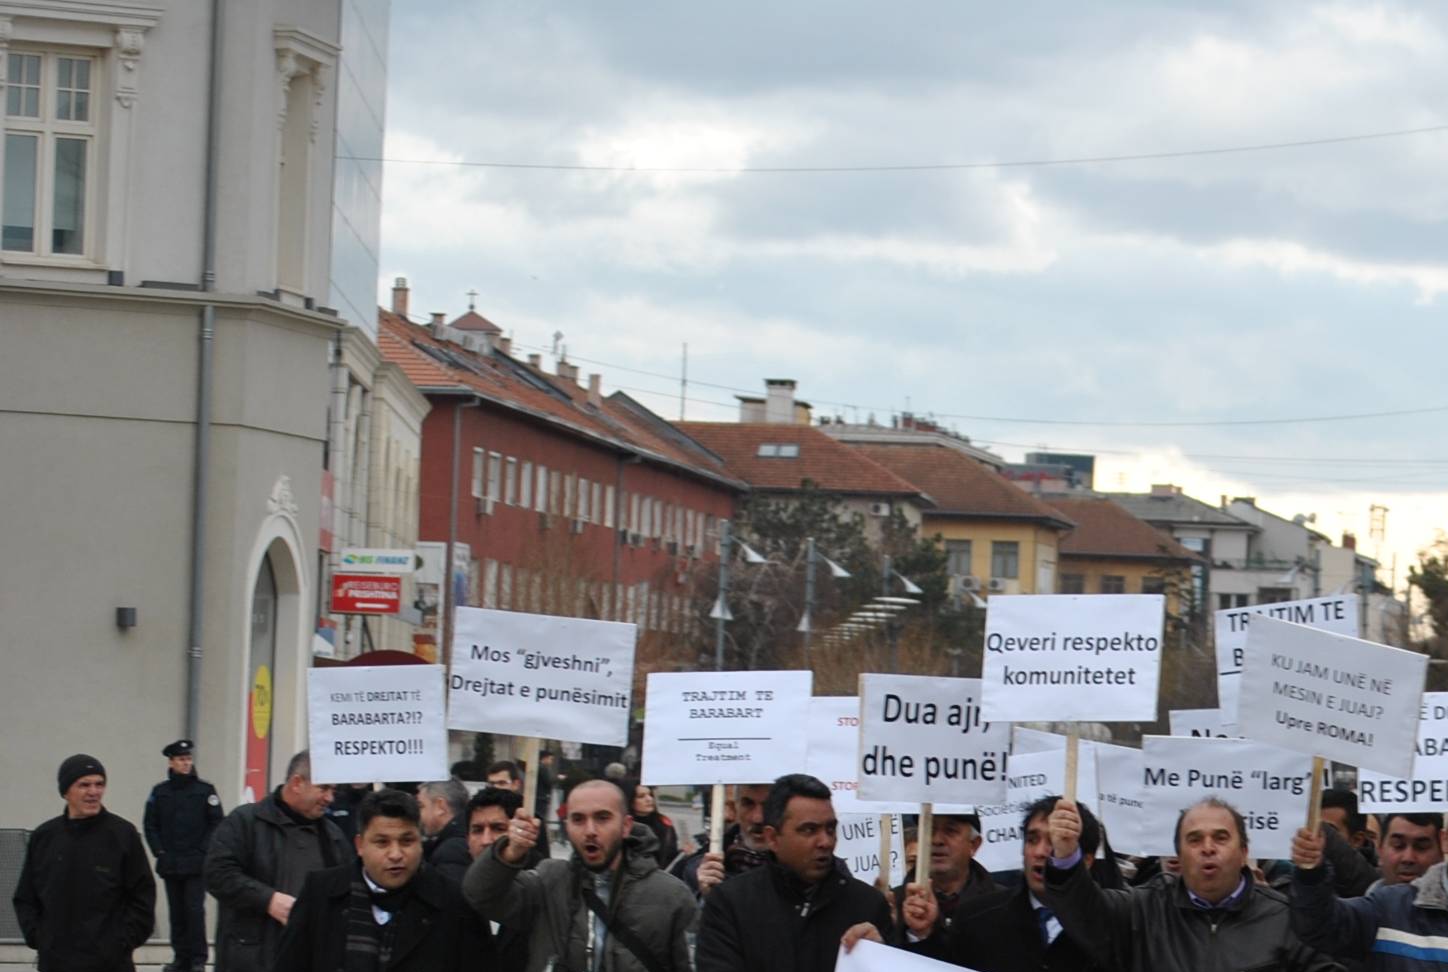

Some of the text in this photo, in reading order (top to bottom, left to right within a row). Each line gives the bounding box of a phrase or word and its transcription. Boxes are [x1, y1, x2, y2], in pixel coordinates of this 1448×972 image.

[1227, 601, 1344, 632] TRTIM TE
[470, 645, 510, 663] Mos
[987, 632, 1158, 655] Qeveri respekto
[1003, 665, 1136, 685] komunitetet
[1272, 653, 1393, 696] KU JAM UNË NË
[367, 691, 408, 702] DREJTAT
[451, 674, 628, 709] Drejtat e punësimit
[682, 690, 774, 702] TRAJTIM TE
[1272, 681, 1384, 720] MESIN E JUAJ?
[332, 711, 423, 725] BARABARTA?!?
[689, 708, 763, 719] BARABART
[883, 694, 937, 724] Dua
[837, 716, 860, 727] STO
[1275, 710, 1374, 747] Upre ROMA!
[334, 739, 424, 755] RESPEKTO!!!
[708, 741, 739, 752] Equal
[862, 745, 1007, 785] dhe punë!
[1007, 773, 1047, 788] NITED
[1144, 768, 1180, 787] Me
[1187, 769, 1243, 789] Punë
[842, 816, 875, 840] UNË
[854, 850, 898, 873] JUA?
